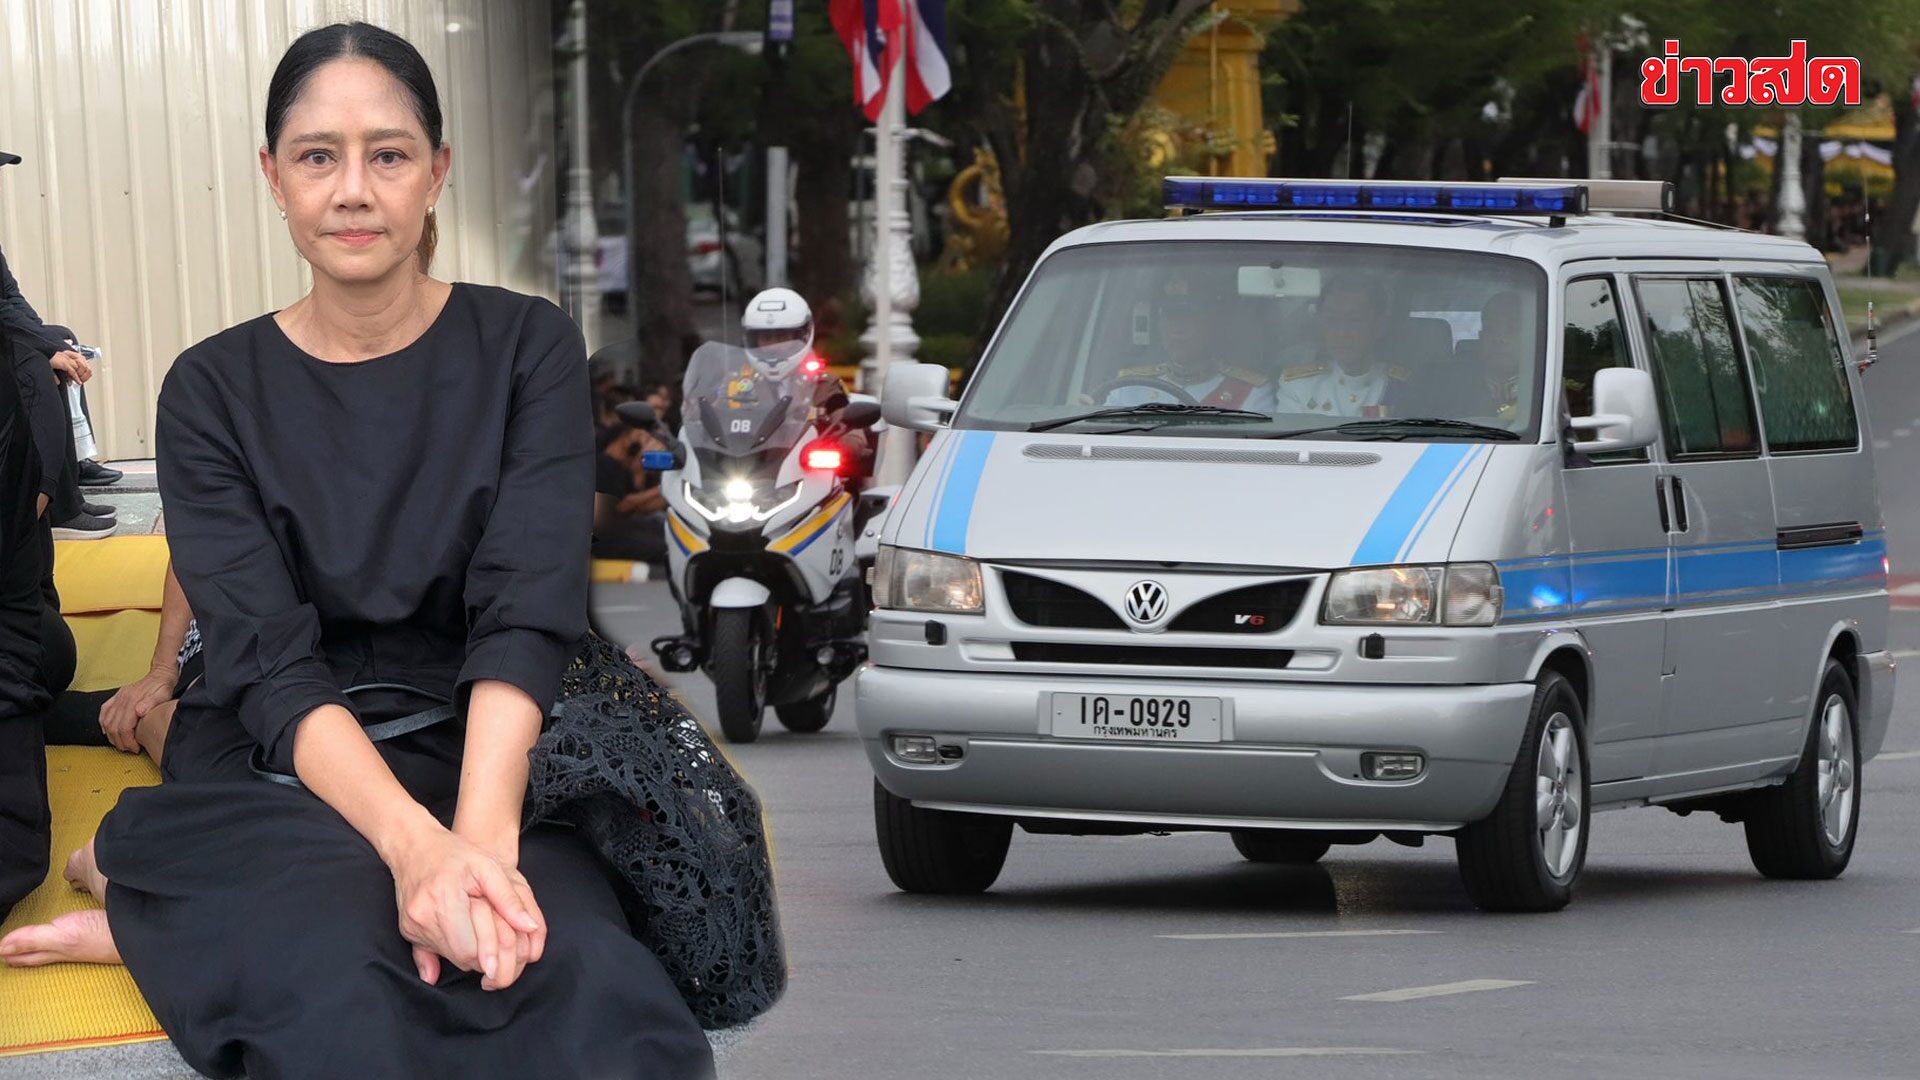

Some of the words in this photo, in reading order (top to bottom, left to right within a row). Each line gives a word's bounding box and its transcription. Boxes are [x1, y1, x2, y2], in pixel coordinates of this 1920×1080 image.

[1234, 614, 1265, 626] V6
[1093, 726, 1177, 738] กรุงเทพมหานคร
